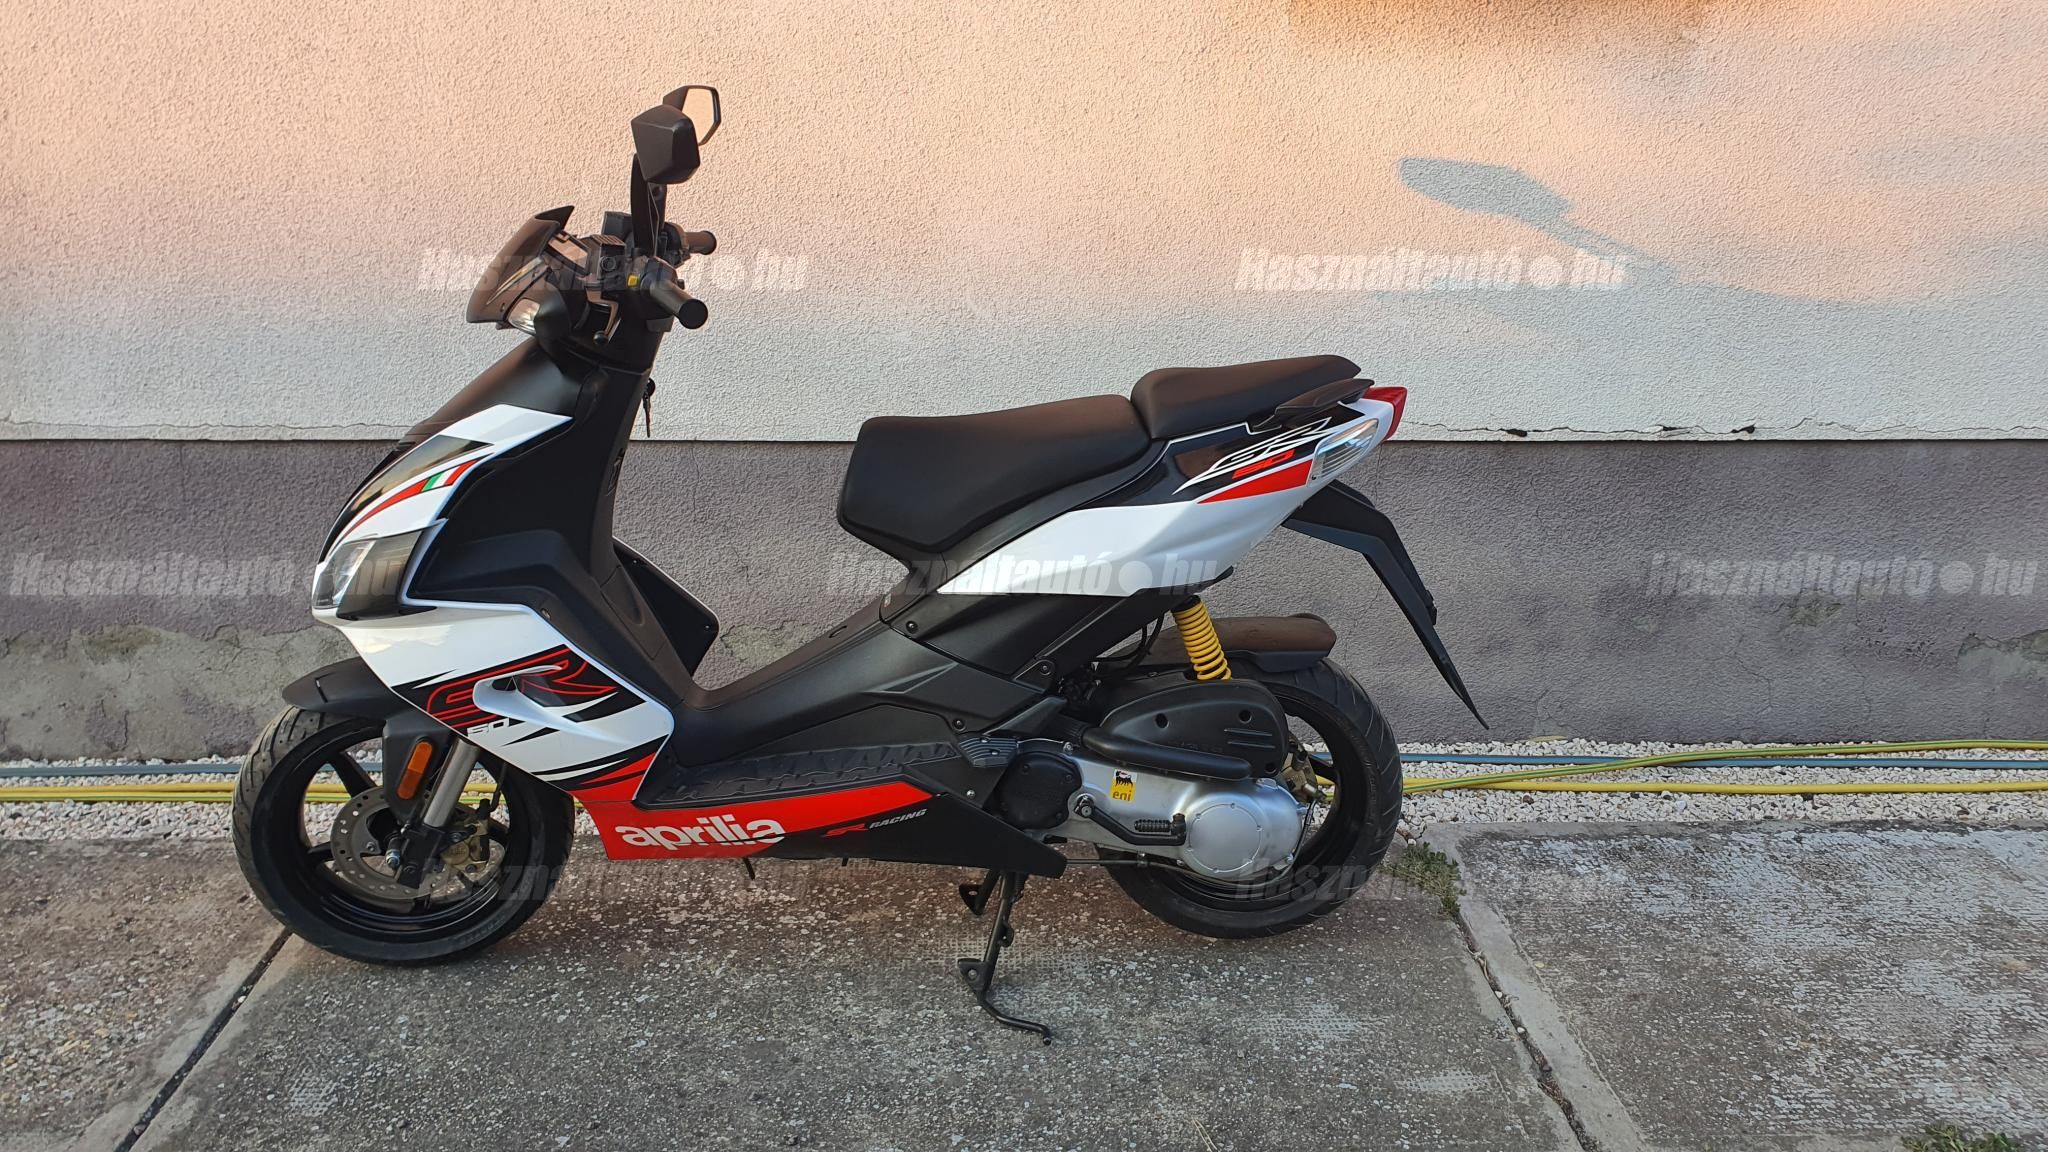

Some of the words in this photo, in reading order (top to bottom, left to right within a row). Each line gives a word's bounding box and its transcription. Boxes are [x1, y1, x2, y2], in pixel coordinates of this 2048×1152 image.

[467, 718, 509, 736] 50
[1112, 789, 1132, 801] eni
[869, 809, 927, 828] RACING
[615, 814, 785, 850] aprilia
